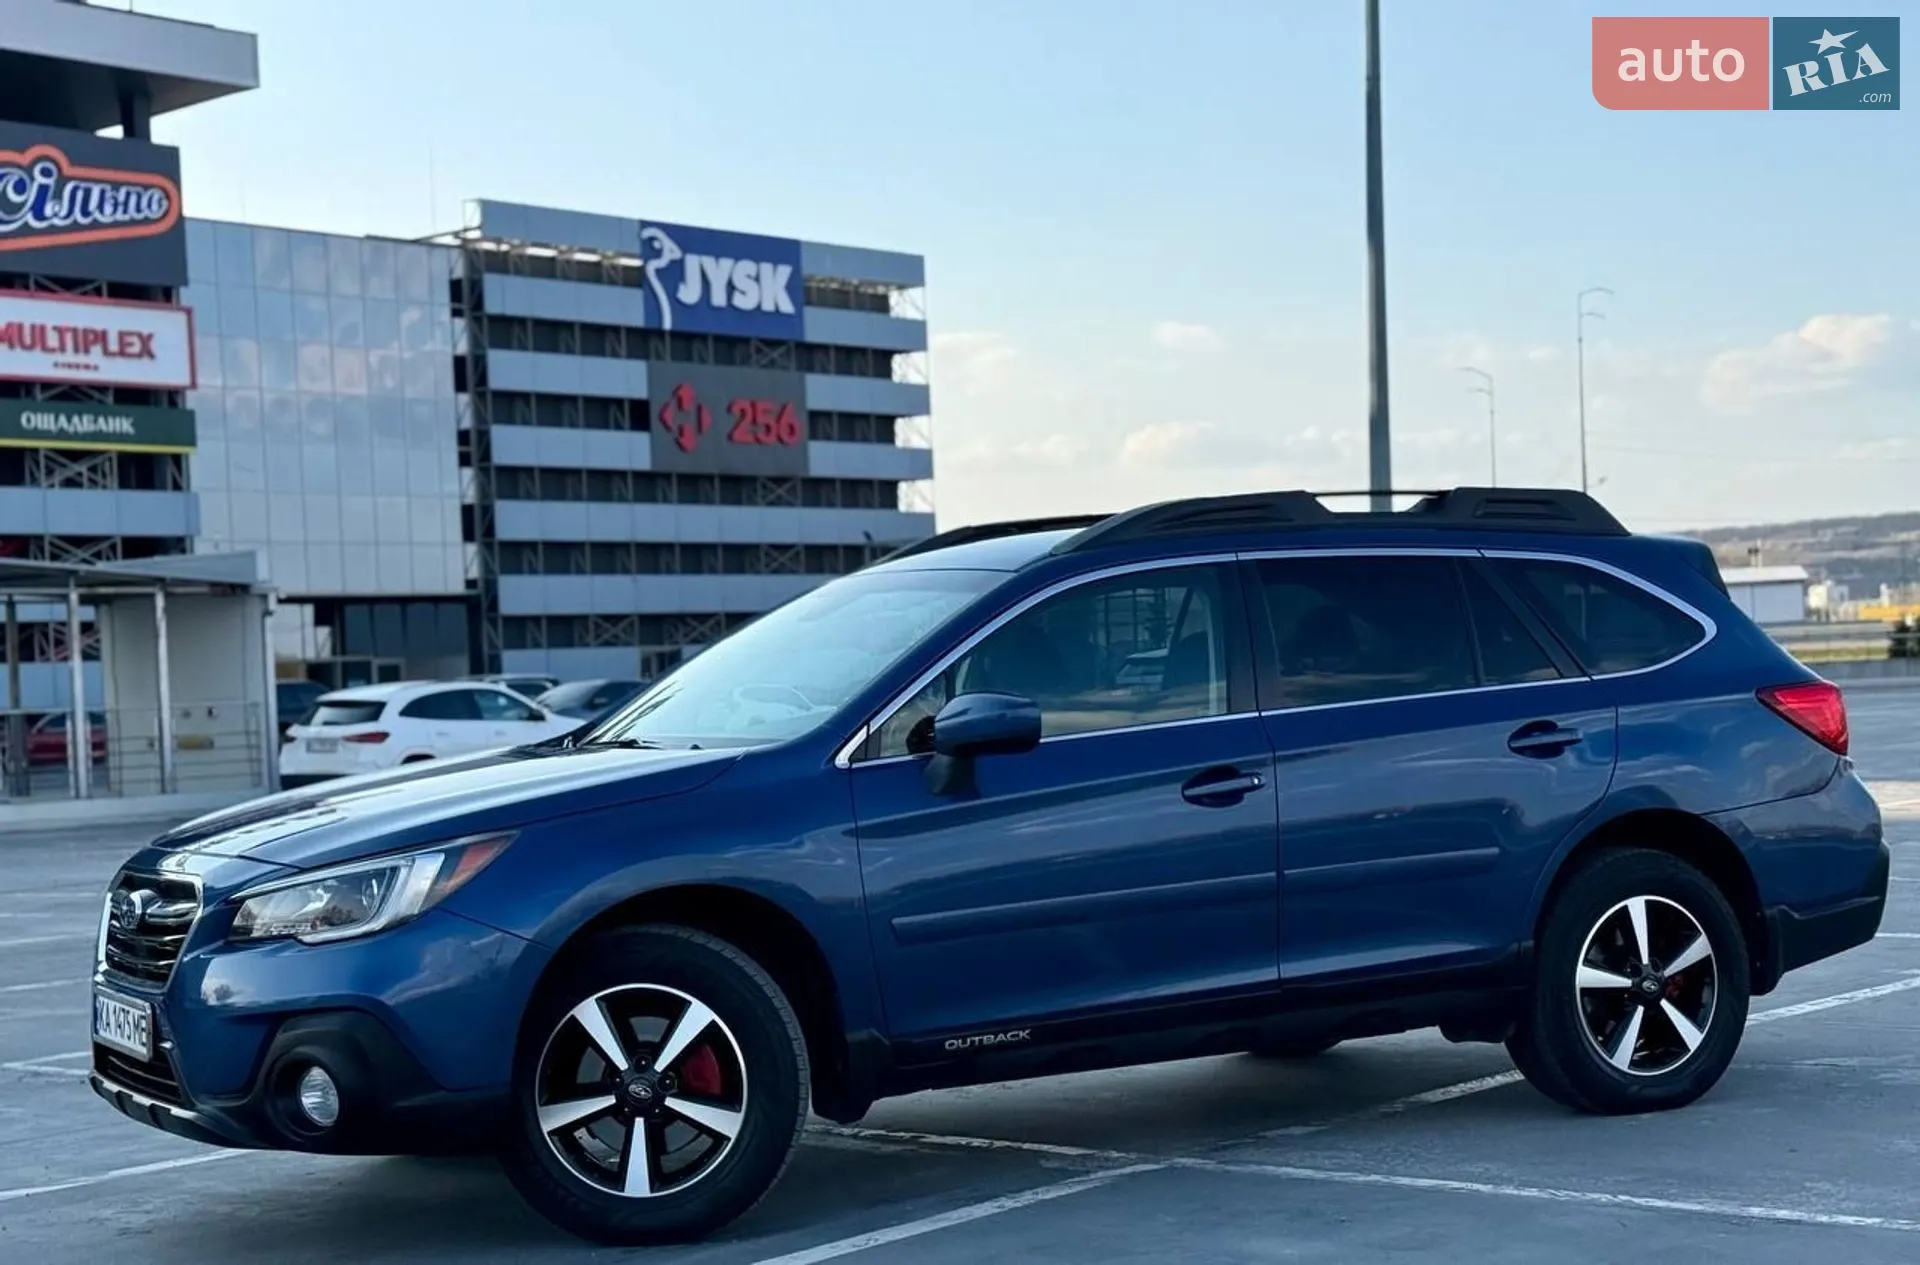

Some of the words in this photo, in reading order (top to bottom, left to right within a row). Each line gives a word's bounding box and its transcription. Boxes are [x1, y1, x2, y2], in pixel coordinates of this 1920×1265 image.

[676, 253, 796, 315] JYSK
[20, 410, 136, 435] ОЩАДБАНК
[727, 399, 801, 446] 256
[944, 1029, 1032, 1050] OUTBACK
